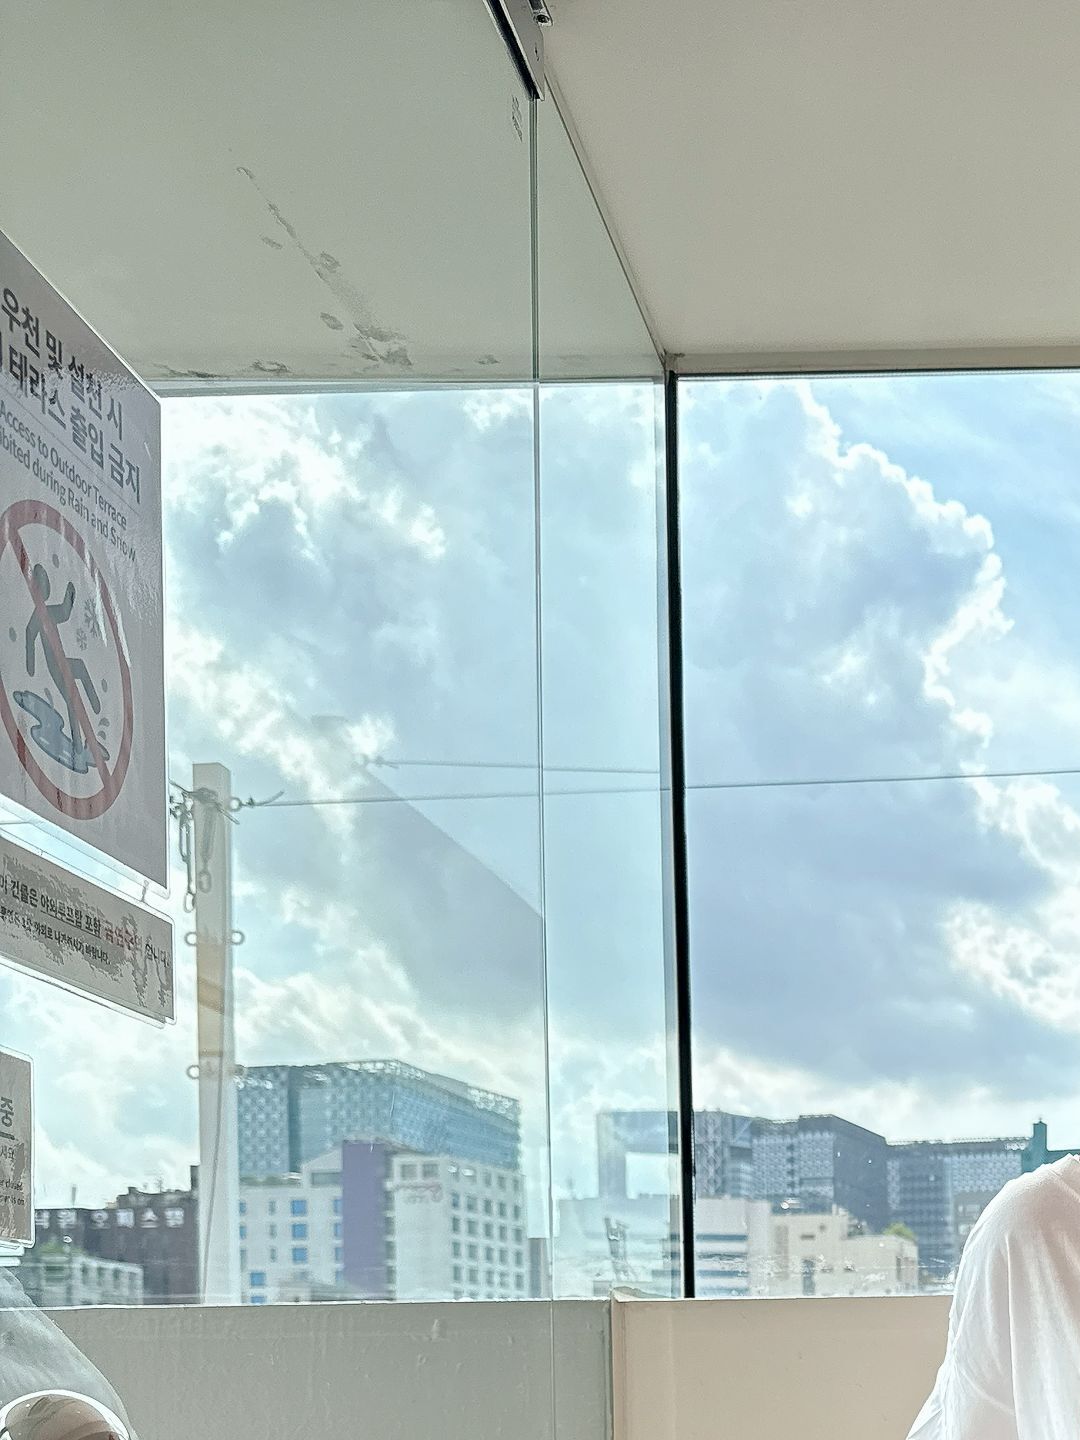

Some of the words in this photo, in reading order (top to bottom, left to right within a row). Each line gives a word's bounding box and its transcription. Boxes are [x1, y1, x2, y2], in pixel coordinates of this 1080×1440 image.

[2, 287, 40, 358] 우천
[46, 330, 63, 381] 및
[107, 397, 122, 441] 시
[9, 345, 66, 429] 테라스
[70, 406, 104, 470] 출입
[109, 443, 140, 505] 금지
[0, 400, 36, 448] Access
[37, 436, 48, 459] to
[50, 447, 93, 499] Outdoor
[93, 484, 127, 531] Terrace
[32, 458, 66, 506] during
[68, 487, 89, 522] Rain
[91, 512, 109, 538] and
[110, 527, 137, 562] Snow
[11, 880, 38, 908] 건물은
